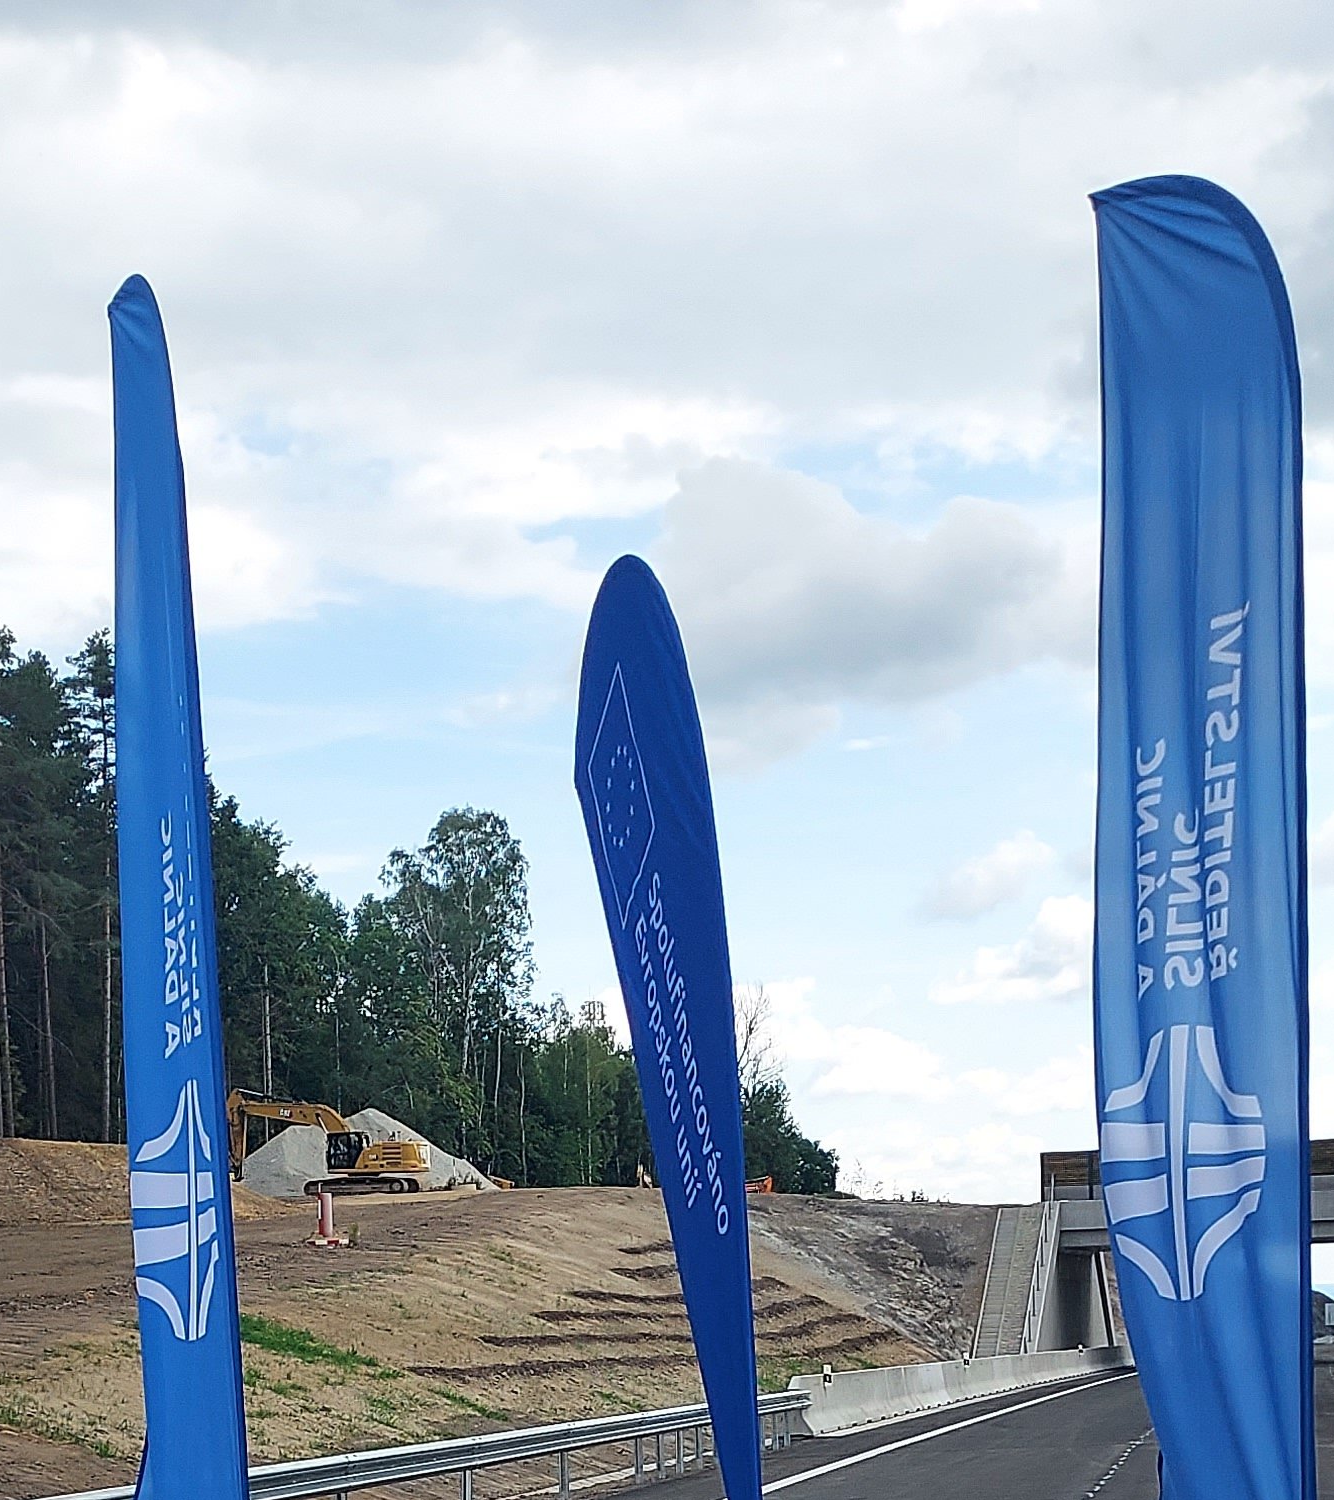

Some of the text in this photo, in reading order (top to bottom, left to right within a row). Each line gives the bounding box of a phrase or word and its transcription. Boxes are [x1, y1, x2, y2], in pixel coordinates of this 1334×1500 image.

[634, 912, 702, 1208] Evropskou unií
[649, 872, 729, 1235] Spolufinancováno
